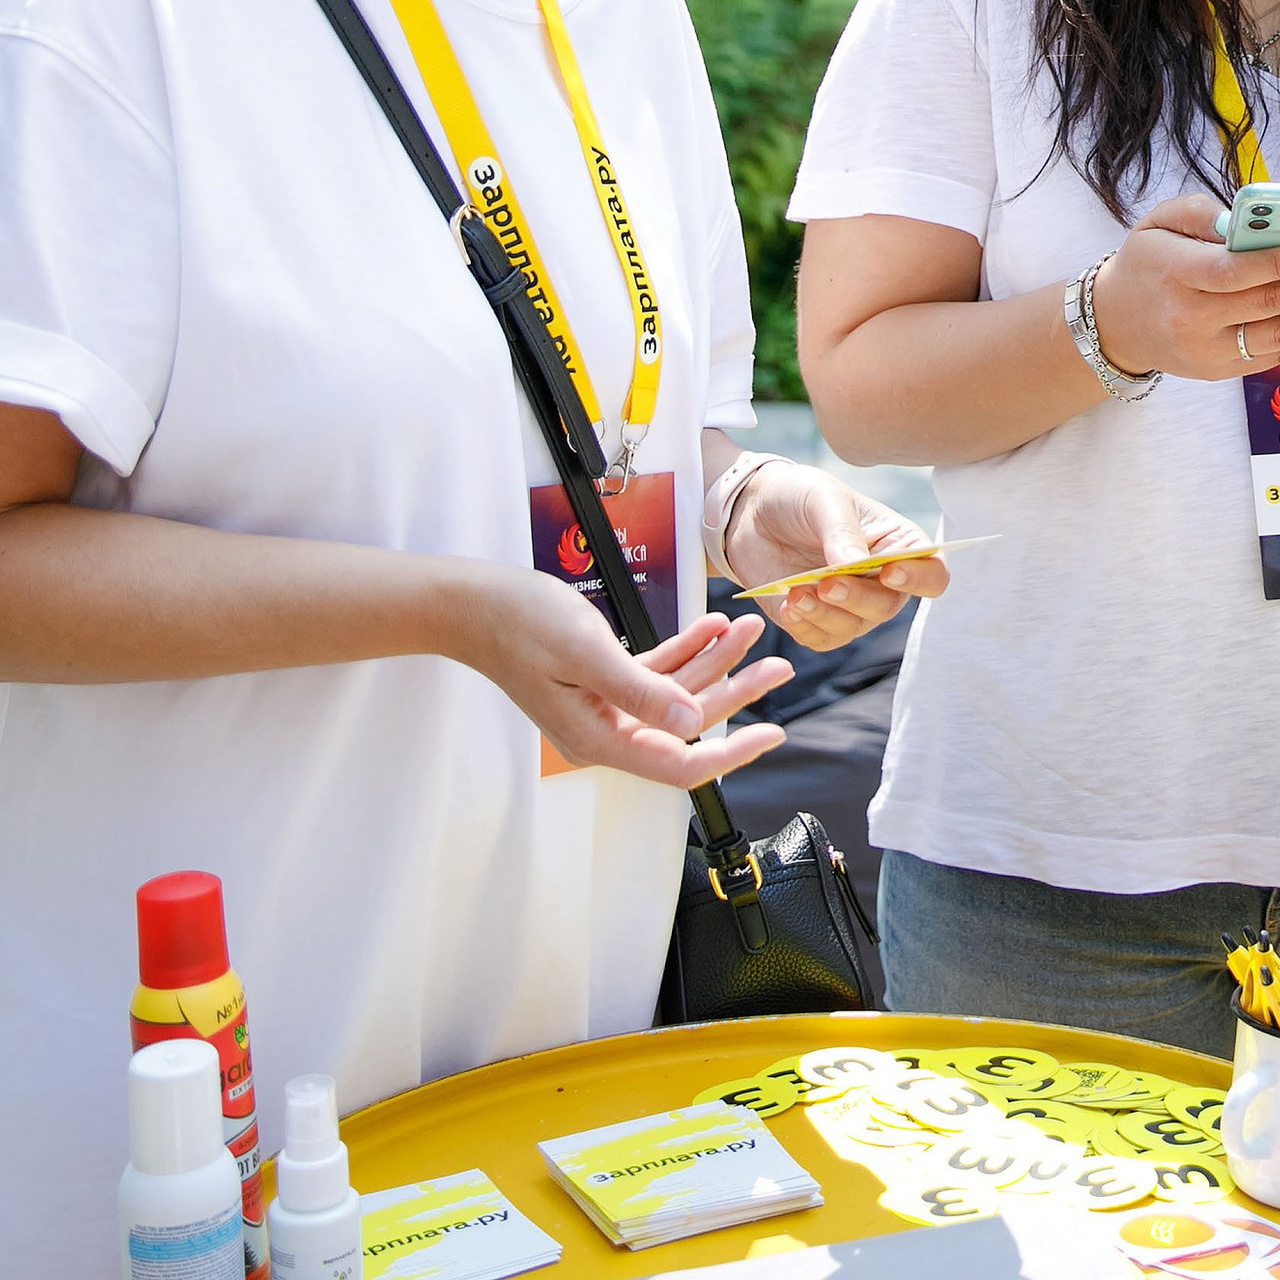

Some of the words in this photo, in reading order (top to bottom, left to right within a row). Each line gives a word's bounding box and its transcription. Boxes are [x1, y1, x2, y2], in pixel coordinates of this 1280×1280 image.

[591, 146, 659, 354] зарплата.ру
[593, 1138, 757, 1183] зарплата.ру
[362, 1210, 509, 1256] рплата.ру
